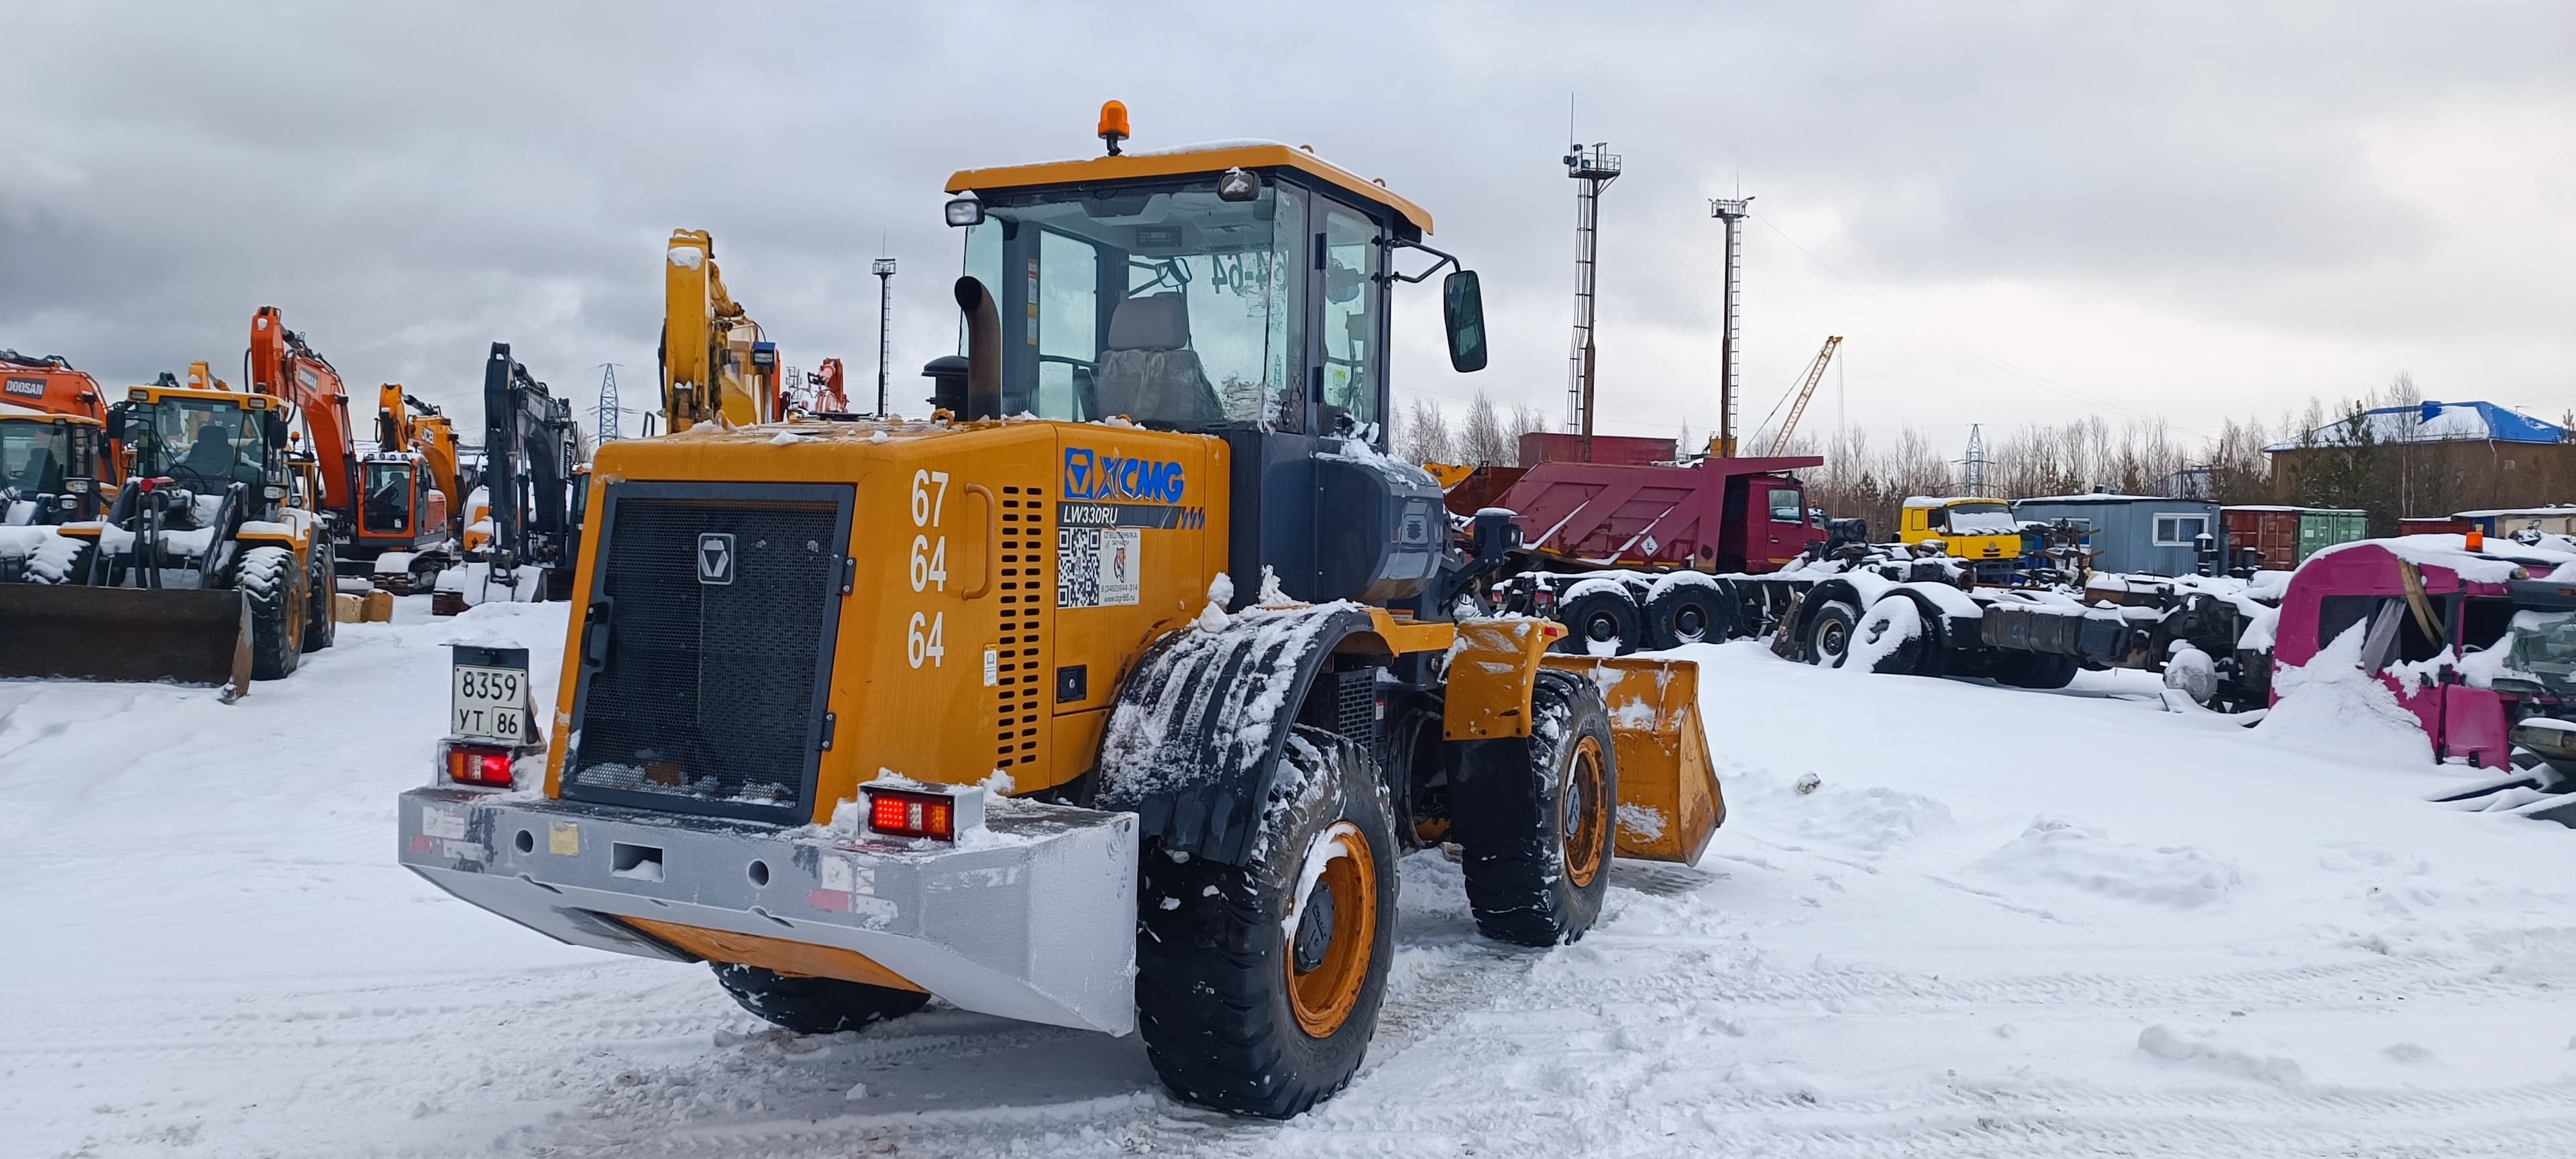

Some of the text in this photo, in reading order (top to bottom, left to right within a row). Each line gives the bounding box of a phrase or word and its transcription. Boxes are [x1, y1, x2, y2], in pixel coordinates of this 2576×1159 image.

[6, 380, 44, 395] DOOSAN
[912, 469, 949, 527] 67
[1094, 456, 1184, 504] XCMG
[1063, 506, 1118, 524] LW330RU
[910, 535, 947, 592] 64
[908, 611, 944, 669] 64
[463, 671, 517, 702] 8359
[460, 709, 517, 734] УТ 86
